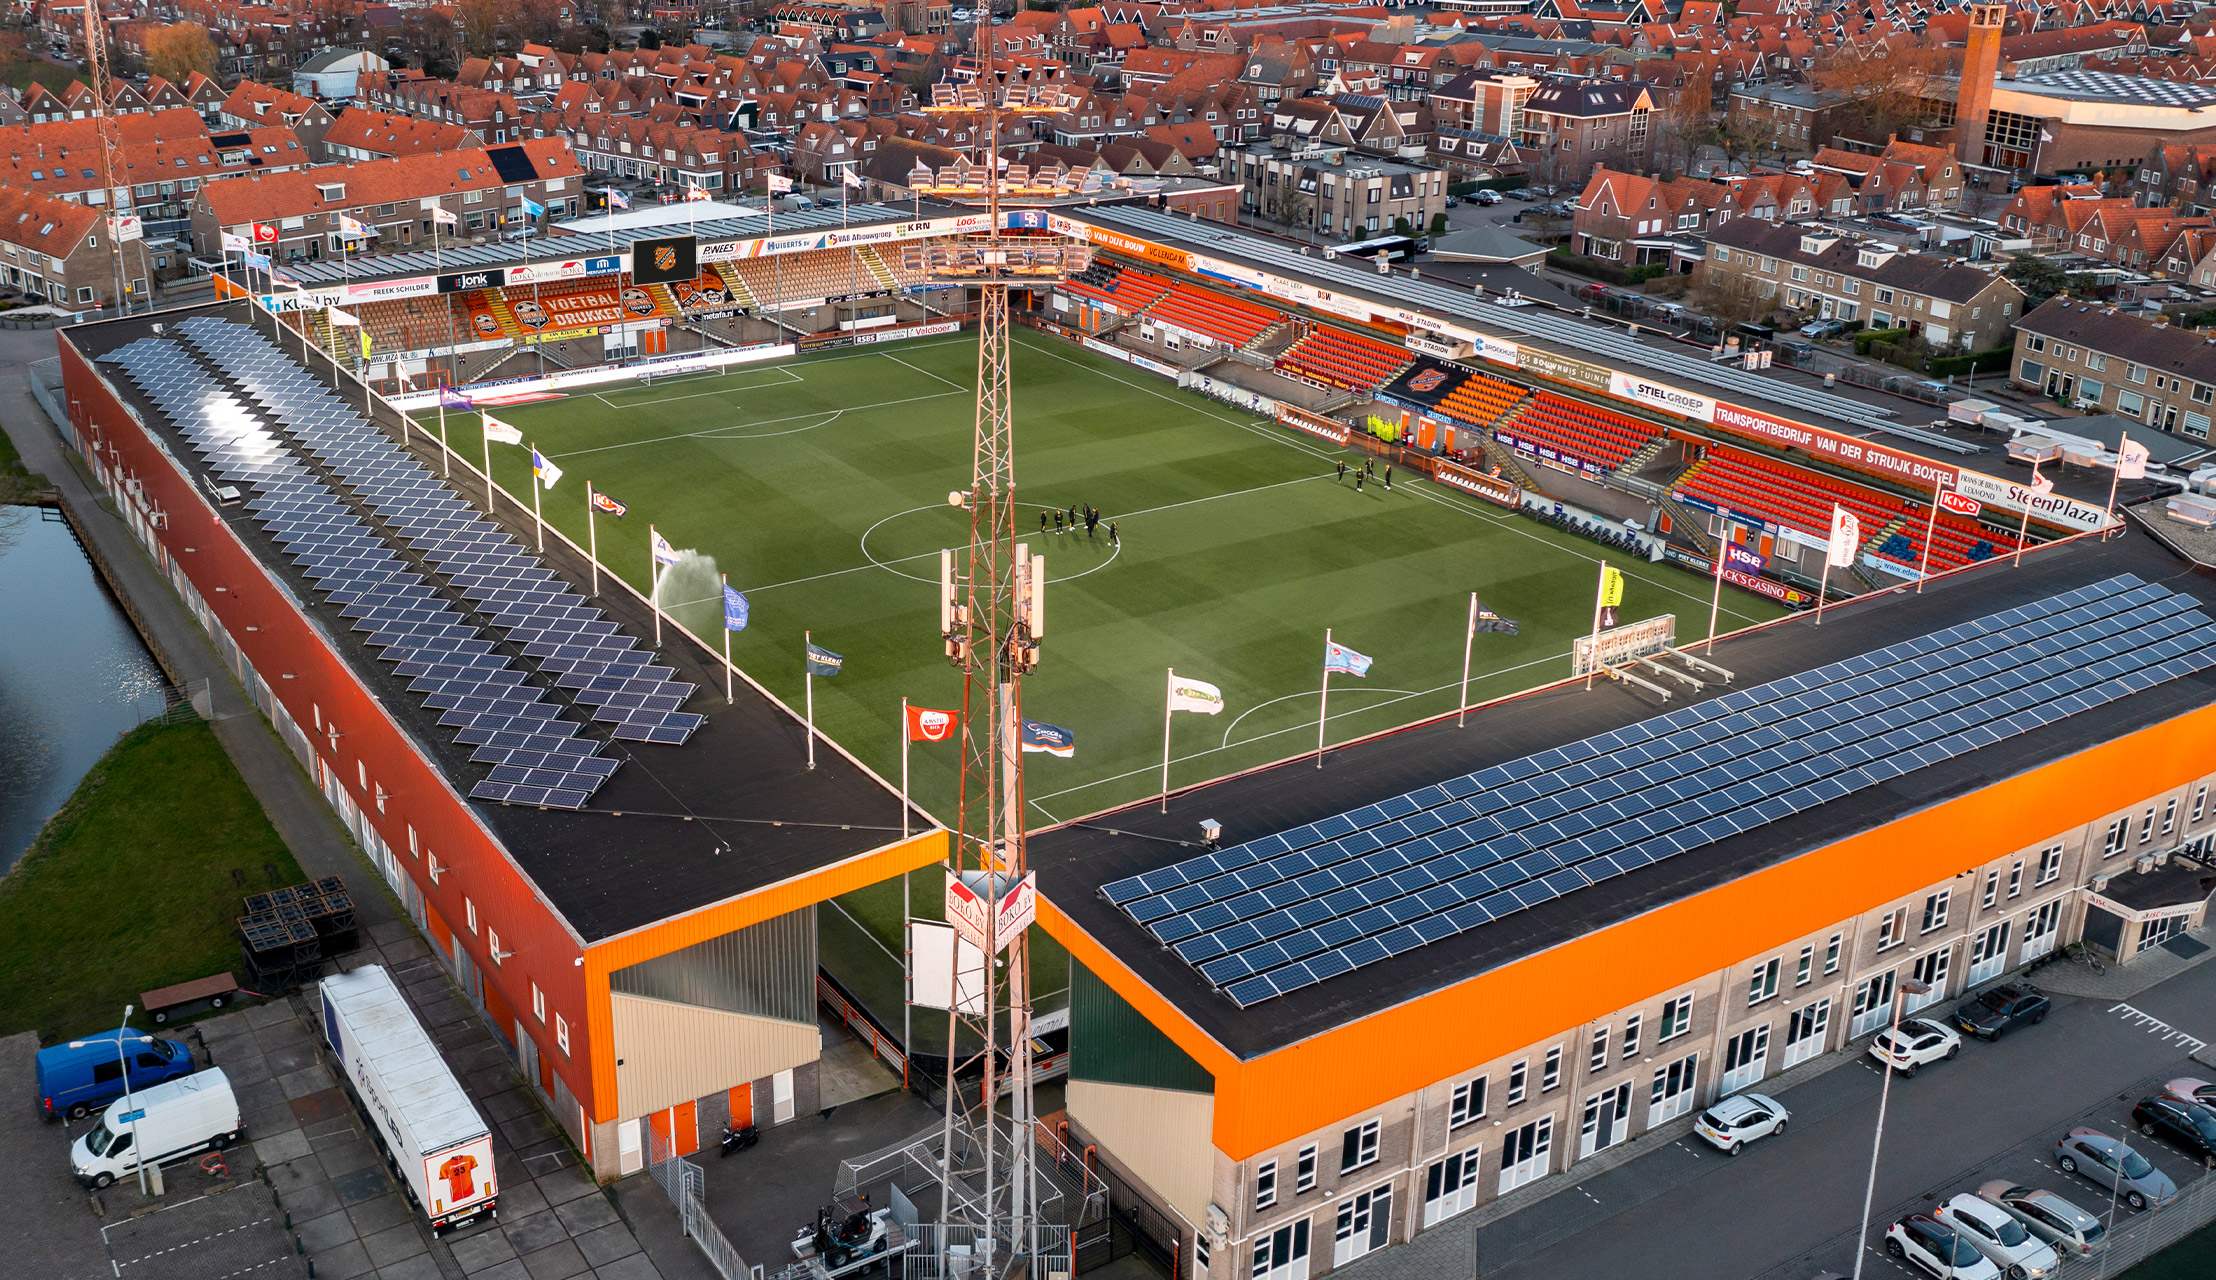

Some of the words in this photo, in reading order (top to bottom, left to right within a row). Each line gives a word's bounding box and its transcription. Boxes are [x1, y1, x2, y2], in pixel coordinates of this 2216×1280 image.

[908, 222, 930, 232] KRN
[956, 218, 976, 226] LOOS
[838, 233, 850, 243] VAB
[852, 232, 892, 242] Afbouwgroep
[1094, 230, 1108, 242] VAN
[1109, 235, 1123, 248] DIJK
[1124, 240, 1146, 253] BOUW
[1150, 248, 1186, 264] VOLENDAM
[373, 288, 396, 296] FREEK
[397, 284, 430, 293] SCHILDER
[323, 295, 340, 306] bv
[546, 293, 618, 310] VOETBAL
[554, 306, 625, 326] DRUKKER
[703, 310, 734, 321] metafa.nl
[1416, 318, 1442, 330] STADION
[916, 326, 950, 336] Veldboer
[1424, 342, 1449, 354] STADION
[1516, 353, 1530, 362] JOS
[1533, 357, 1576, 376] BOUWHUIS
[1580, 370, 1611, 385] TUINEN
[1375, 392, 1398, 406] KEUKEN
[1638, 384, 1666, 400] STIEL
[1667, 392, 1704, 410] GROEP
[1427, 410, 1450, 423] KEUKEN
[1497, 434, 1513, 445] HSB
[1518, 441, 1534, 452] HSB
[1716, 408, 1812, 445] TRANSPORTBEDRIJF
[1816, 436, 1837, 452] VAN
[1840, 442, 1862, 459] DER
[1866, 448, 1911, 474] STRUIJK
[1913, 463, 1956, 487] BOXTEL
[1540, 448, 1556, 459] HSB
[1562, 455, 1578, 466] HSB
[1960, 474, 1977, 486] FRANS
[1978, 479, 1984, 487] DE
[1964, 486, 1996, 500] LEXMOND
[1944, 494, 1976, 512] KIVO
[1988, 525, 2010, 536] DICK
[1678, 554, 1690, 563] PIET
[1690, 558, 1710, 568] KLERKX
[1730, 548, 1762, 568] HSB
[1714, 566, 1748, 585] JACK'S
[1748, 578, 1784, 598] CASINO
[998, 902, 1020, 932] BOKO
[454, 1166, 466, 1176] 23
